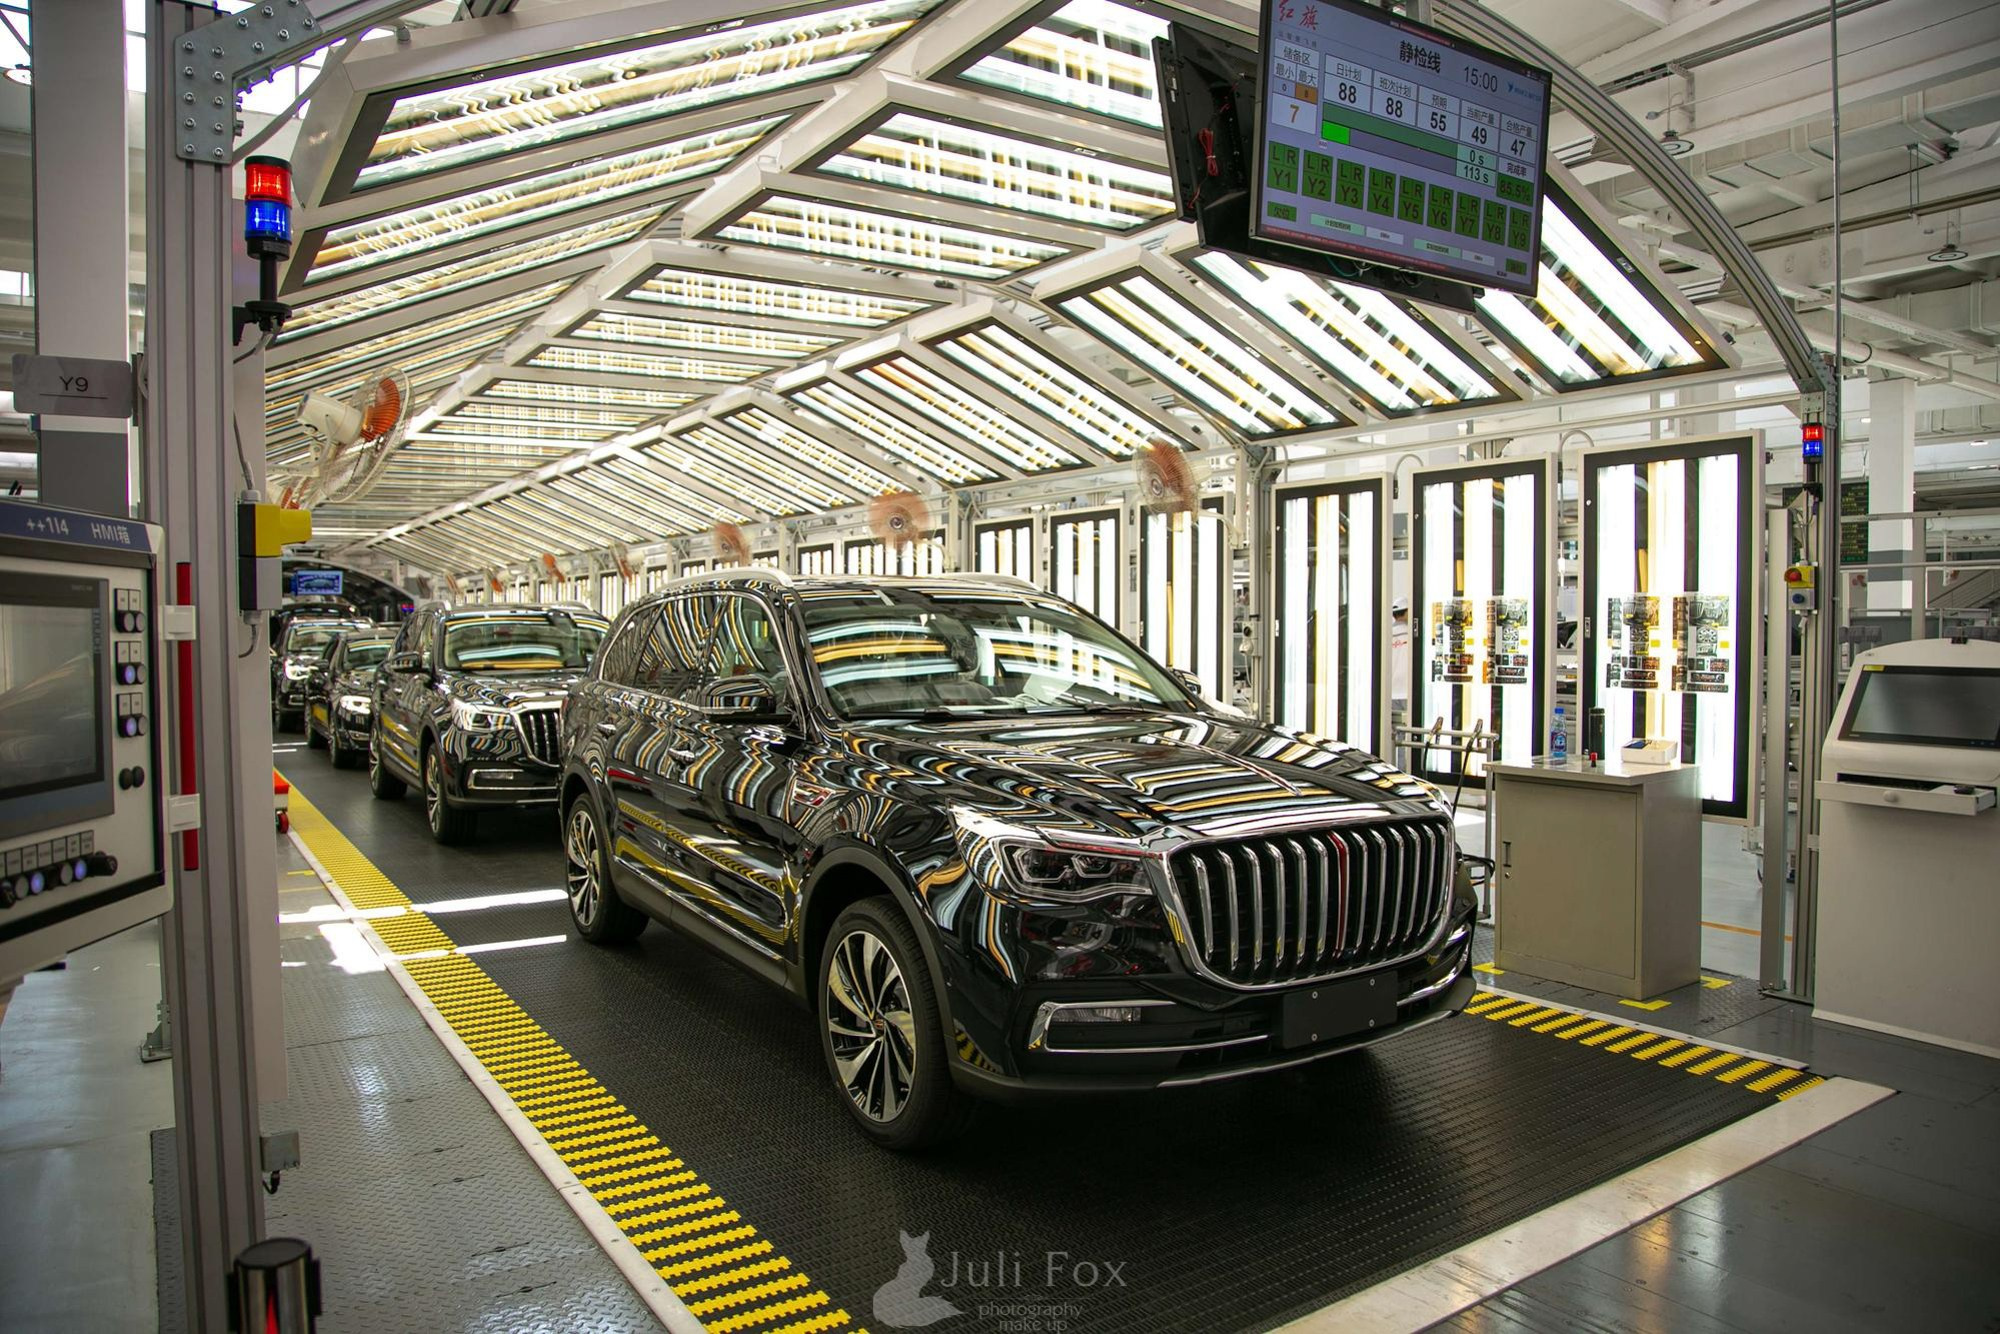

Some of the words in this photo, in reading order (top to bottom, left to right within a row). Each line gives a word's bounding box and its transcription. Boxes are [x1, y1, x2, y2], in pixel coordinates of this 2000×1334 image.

[1284, 46, 1311, 66] 储备区
[1399, 40, 1441, 74] 静检线
[1276, 62, 1294, 79] 最小
[1299, 69, 1316, 86] 最大
[1336, 62, 1362, 82] 日计划
[1464, 65, 1498, 92] 15:00
[1338, 82, 1357, 104] 88
[1379, 77, 1412, 98] 班次计划
[1290, 104, 1300, 123] 7
[1386, 97, 1403, 118] 88
[1467, 106, 1495, 125] 当前产量
[1430, 112, 1446, 132] 55
[1506, 120, 1533, 138] 合格产量
[1471, 126, 1487, 145] 49
[1272, 145, 1280, 161] L
[1287, 149, 1296, 165] R
[1469, 150, 1475, 163] 0
[1511, 139, 1526, 157] 47
[1307, 154, 1314, 170] L
[1321, 158, 1330, 173] R
[1340, 163, 1347, 178] L
[1354, 167, 1362, 182] R
[1464, 165, 1480, 181] 113
[1507, 162, 1527, 177] 完成率
[1273, 168, 1291, 188] Y1
[1308, 176, 1327, 197] Y2
[1372, 172, 1379, 186] L
[1385, 175, 1393, 190] R
[1341, 185, 1359, 205] Y3
[1402, 180, 1409, 194] L
[1414, 183, 1423, 198] R
[1431, 188, 1438, 203] L
[1443, 191, 1451, 206] R
[1500, 181, 1530, 201] 85.5%
[1373, 194, 1389, 213] Y4
[1403, 202, 1419, 219] Y5
[1459, 195, 1466, 210] L
[1470, 198, 1478, 213] R
[1486, 203, 1493, 217] L
[1497, 206, 1504, 220] R
[1432, 209, 1448, 227] Y6
[1460, 217, 1475, 235] Y7
[1512, 210, 1518, 224] L
[1522, 213, 1529, 227] R
[1487, 224, 1501, 243] Y8
[1513, 232, 1527, 249] Y9
[59, 375, 89, 392] Y9
[91, 522, 131, 545] HMI箱
